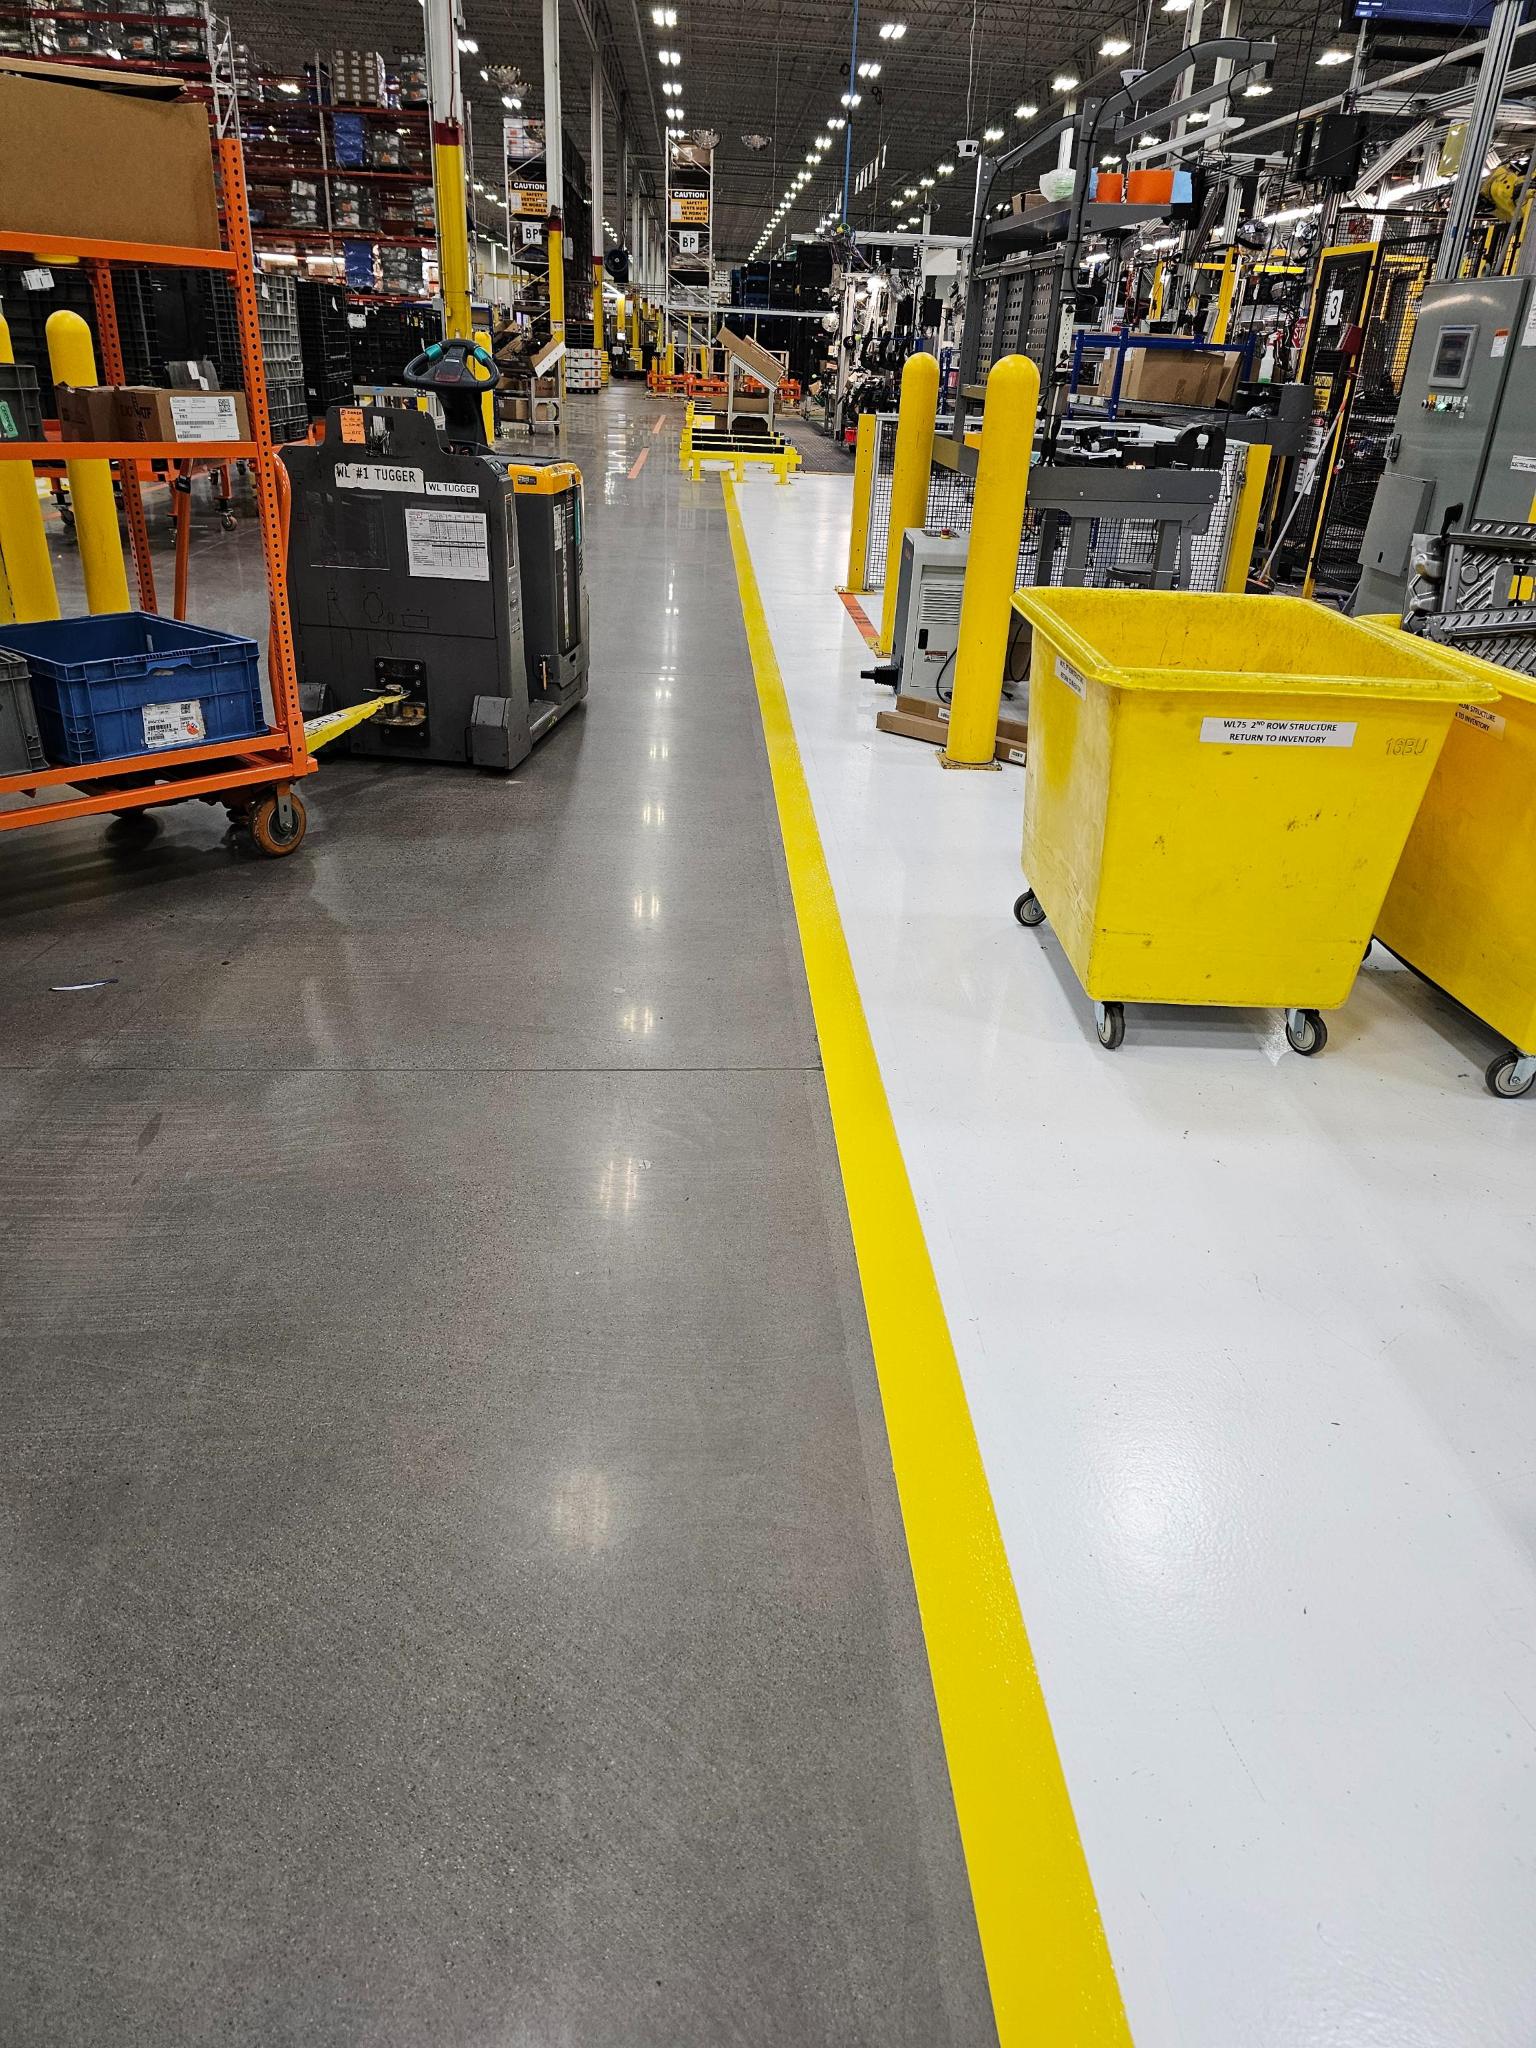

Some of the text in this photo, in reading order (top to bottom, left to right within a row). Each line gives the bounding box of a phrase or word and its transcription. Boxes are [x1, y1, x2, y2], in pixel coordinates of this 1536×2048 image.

[513, 182, 546, 190] CAUTION
[673, 191, 705, 199] CAUTION
[525, 227, 539, 240] BP
[682, 236, 696, 248] BP
[1330, 295, 1339, 320] 3
[336, 465, 416, 483] WL #1 TUGGER
[428, 482, 477, 494] WL TUGGER
[1470, 705, 1496, 722] STRUCTURE
[1223, 720, 1247, 729] WL75
[1266, 722, 1288, 730] ROW
[1289, 723, 1338, 732] STRUCTURE
[1464, 714, 1490, 731] INVENTORY
[1229, 733, 1327, 744] RETURN TO INVENTORY
